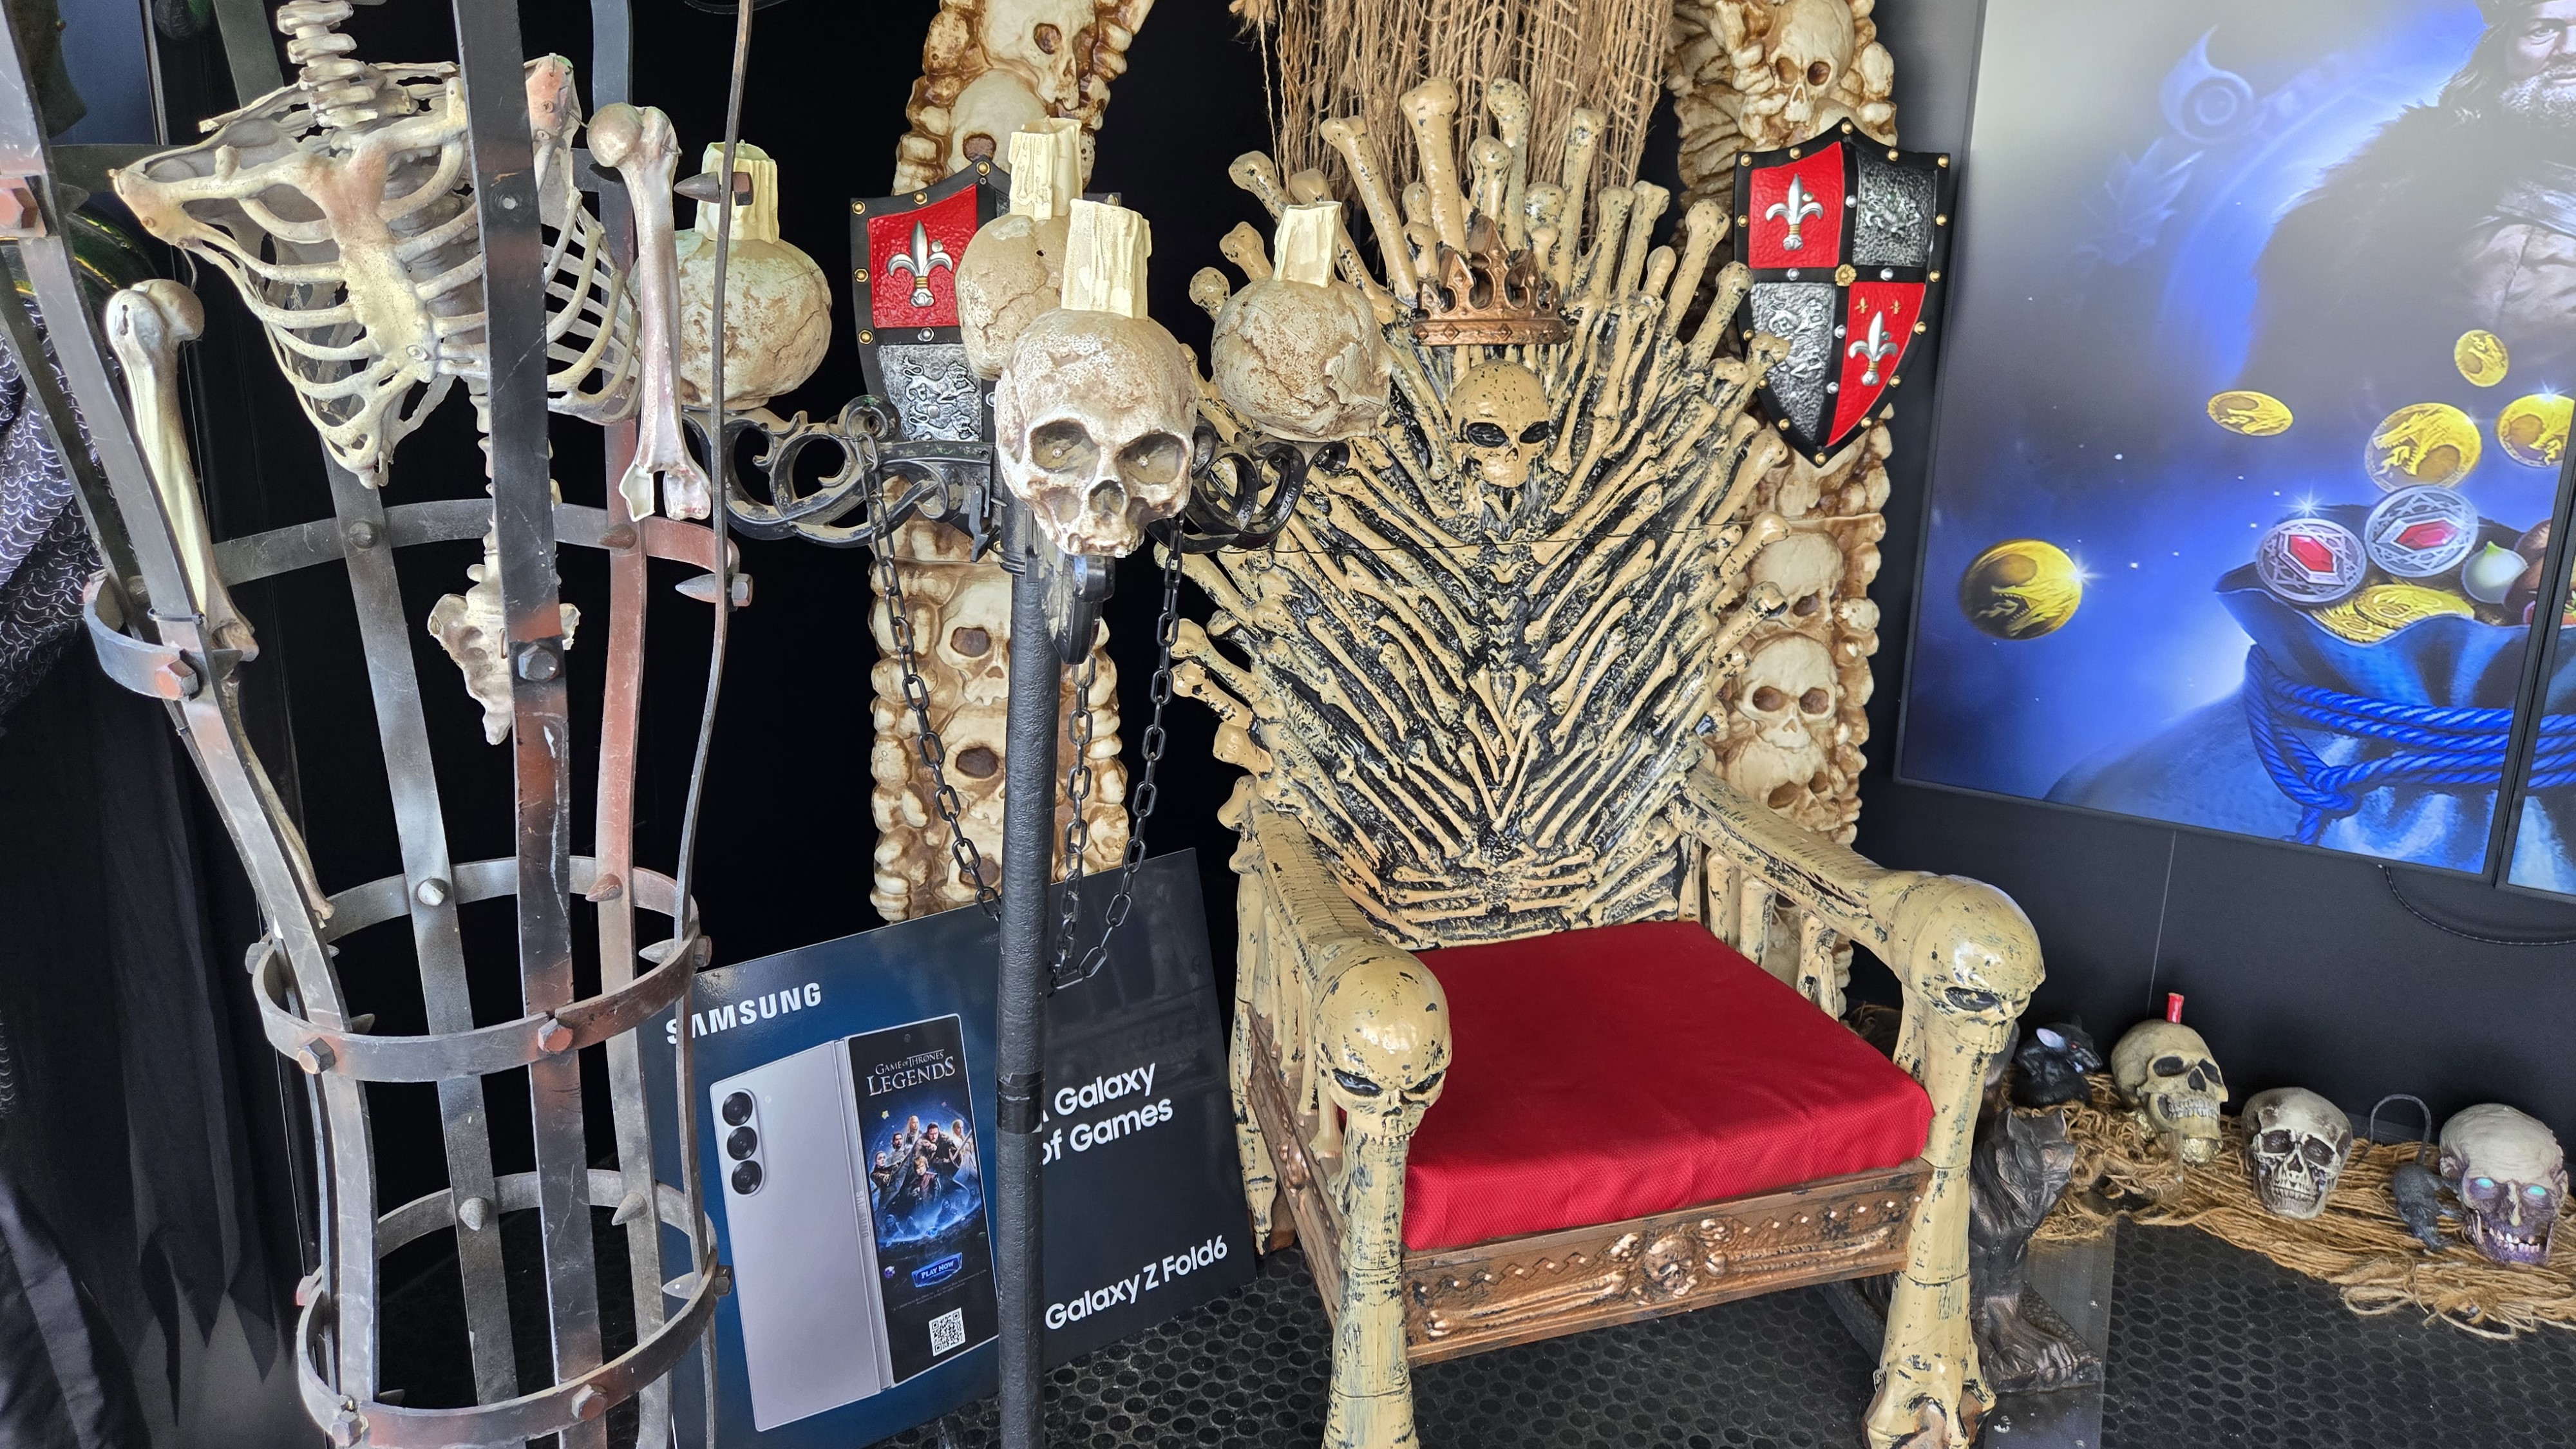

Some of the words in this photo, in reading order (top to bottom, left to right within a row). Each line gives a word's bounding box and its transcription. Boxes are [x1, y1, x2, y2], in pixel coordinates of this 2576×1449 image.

[666, 983, 821, 1044] SAMSUNG
[867, 1056, 955, 1096] LEGENDS
[875, 1061, 902, 1075] GAME
[907, 1049, 944, 1067] THRONES
[1054, 1063, 1155, 1115] Galaxy
[1070, 1099, 1173, 1151] Games
[921, 1268, 937, 1279] PLAY
[938, 1260, 954, 1272] NOW
[1045, 1274, 1140, 1330] Galaxy
[1143, 1262, 1159, 1291] Z
[1162, 1235, 1227, 1282] Fold6
